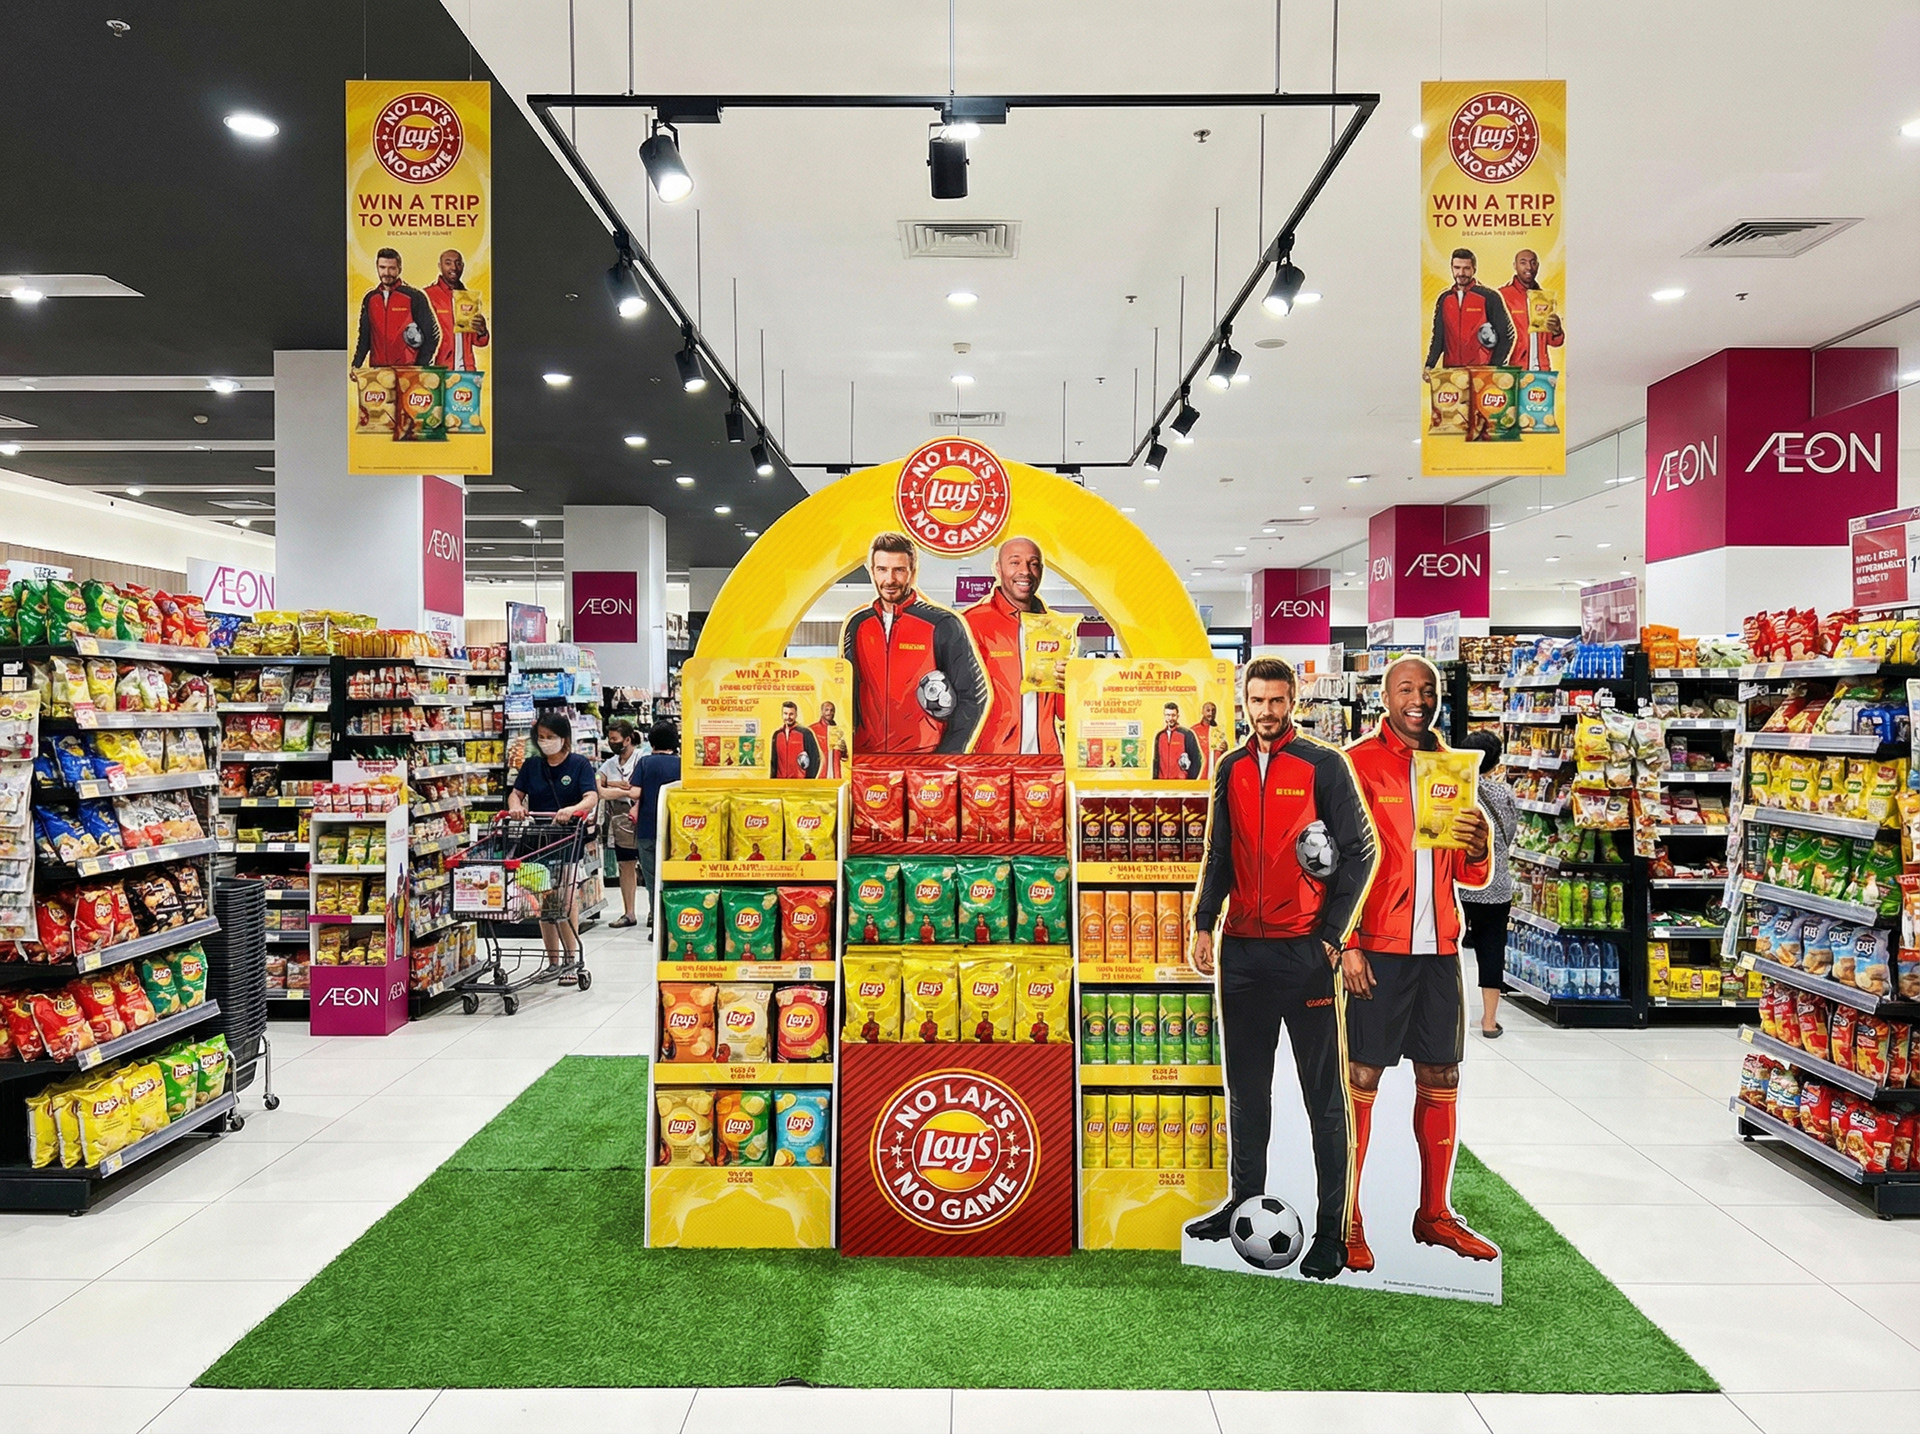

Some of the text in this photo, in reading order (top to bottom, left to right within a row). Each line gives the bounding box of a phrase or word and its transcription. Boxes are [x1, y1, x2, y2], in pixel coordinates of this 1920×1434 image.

[384, 100, 452, 127] NO LAY'S
[1459, 99, 1528, 126] NO LAY'S
[397, 126, 440, 151] Lay's
[1472, 125, 1516, 151] Lay's
[384, 150, 452, 178] NO GAME
[1459, 150, 1528, 178] NO GAME
[358, 194, 480, 210] WIN A TRIP
[1433, 194, 1555, 210] WIN A TRIP
[358, 214, 478, 227] TO WEMBLEY
[1433, 214, 1554, 227] TO WEMBLEY
[912, 446, 996, 479] NO LAY'S
[928, 480, 981, 512] Lay's
[912, 510, 997, 544] NO GAME
[736, 670, 800, 678] WIN A TRIP
[1119, 671, 1182, 680] WIN A TRIP
[895, 1084, 1015, 1129] NO LAY'S
[919, 1131, 994, 1173] Lay's
[894, 1172, 1018, 1220] NO GAME
